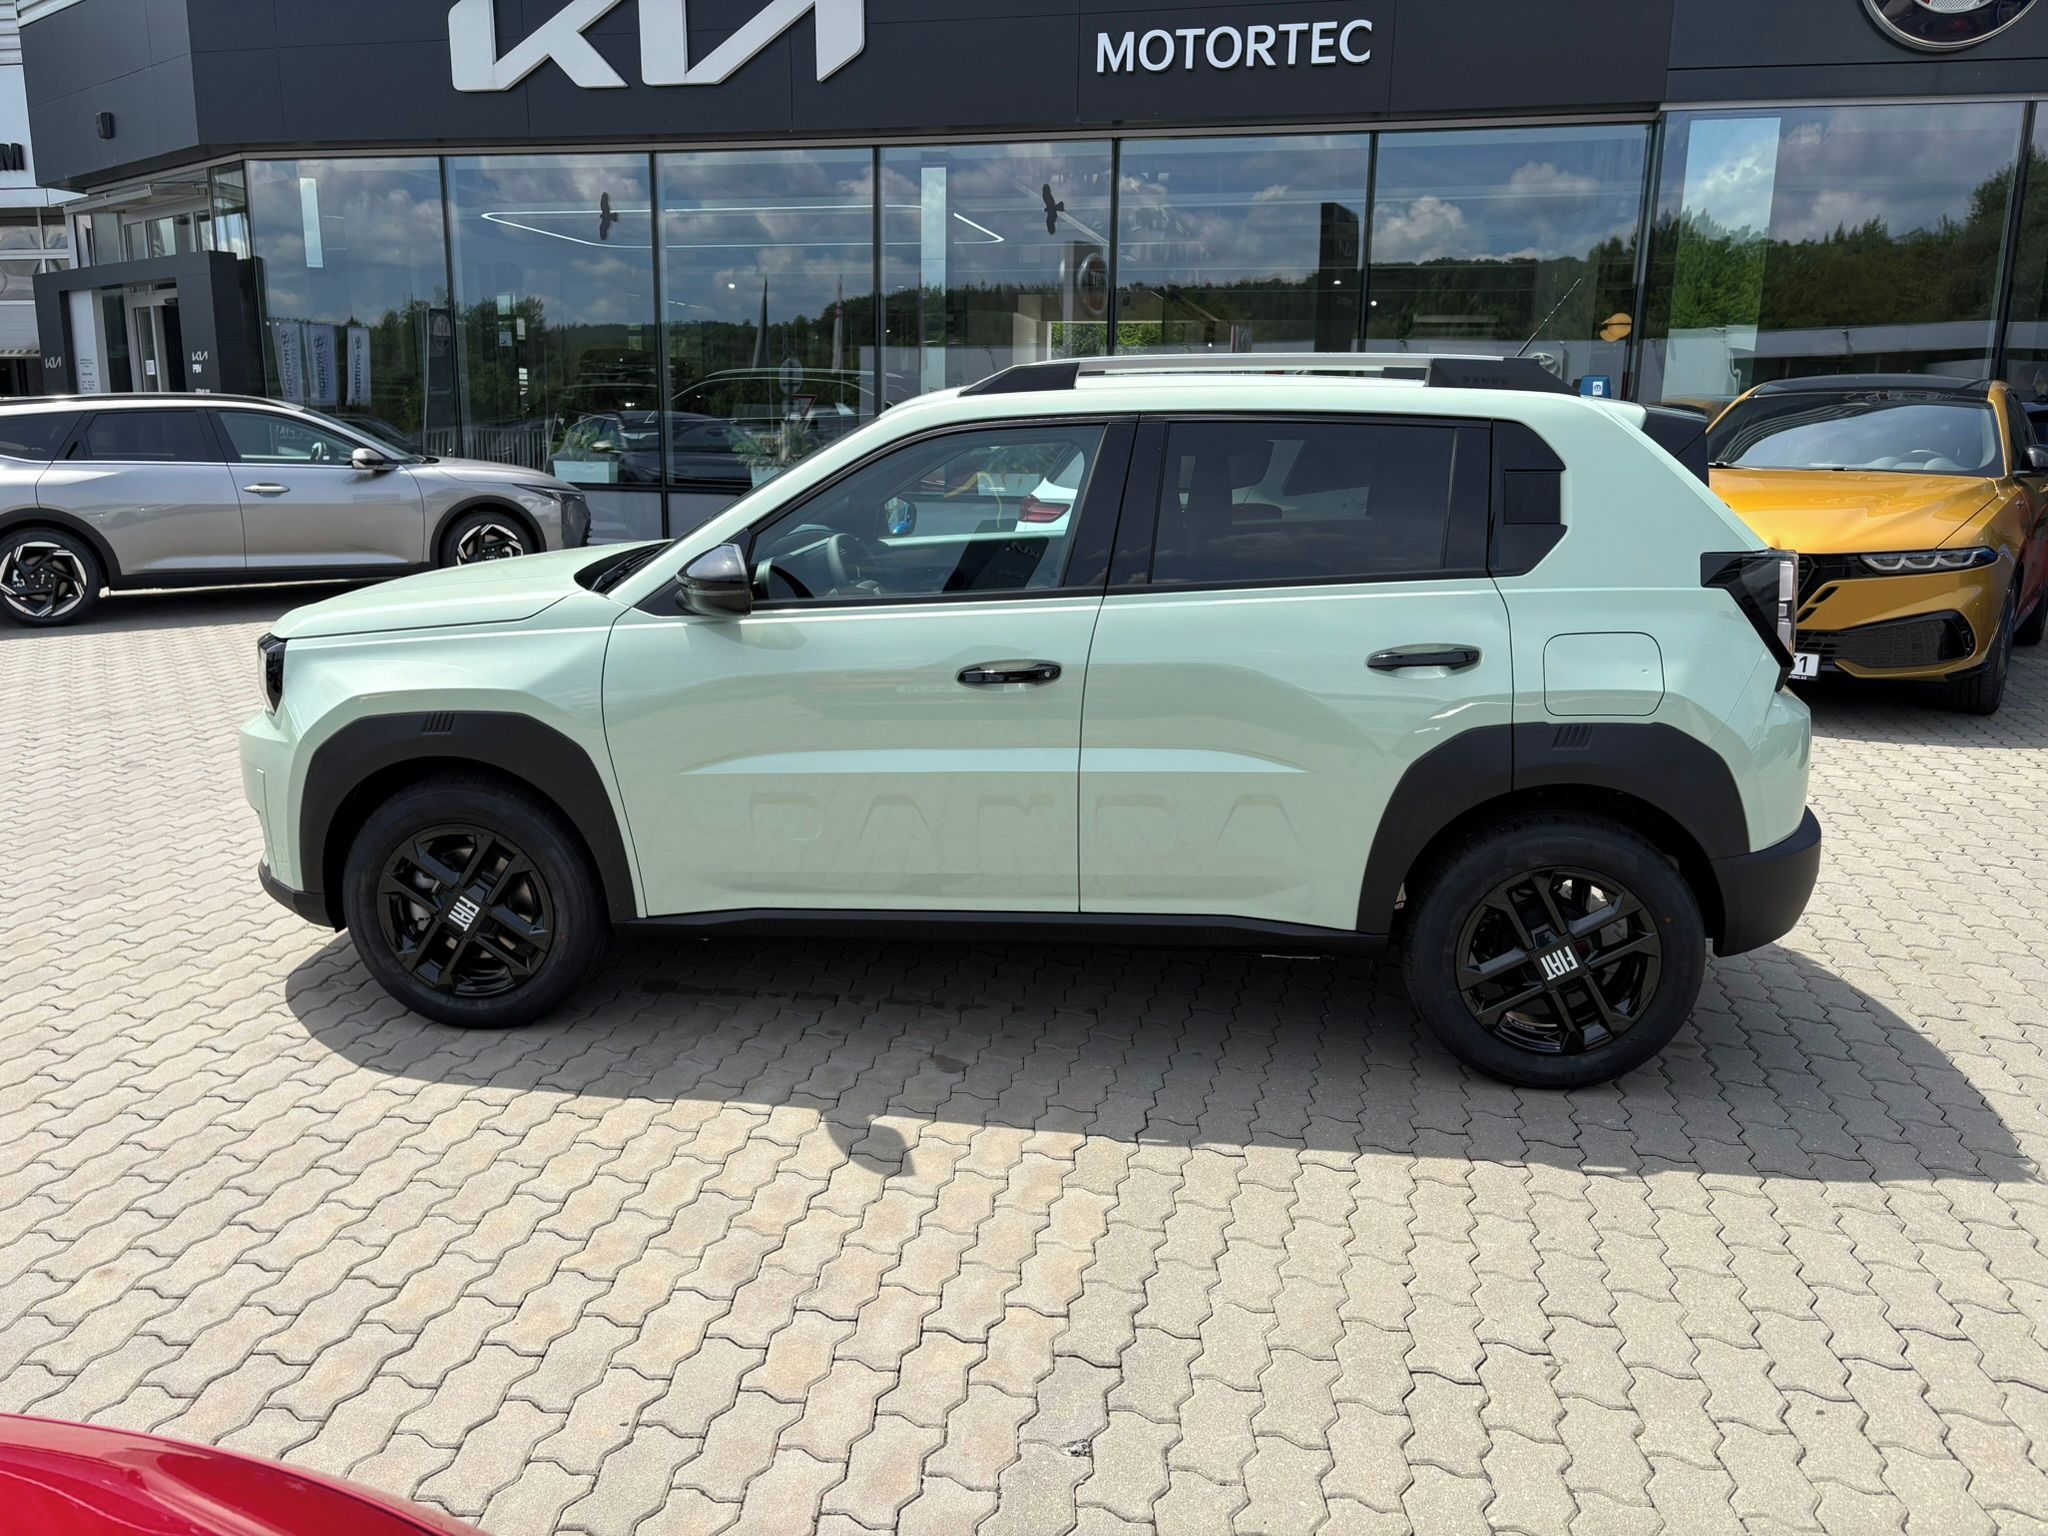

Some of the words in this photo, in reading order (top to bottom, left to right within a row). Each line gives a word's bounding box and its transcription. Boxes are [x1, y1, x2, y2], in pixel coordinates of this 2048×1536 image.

[448, 0, 865, 92] KIA
[1096, 19, 1373, 73] MOTORTEC
[448, 895, 480, 931] FIAT
[1540, 946, 1579, 980] FIAT
